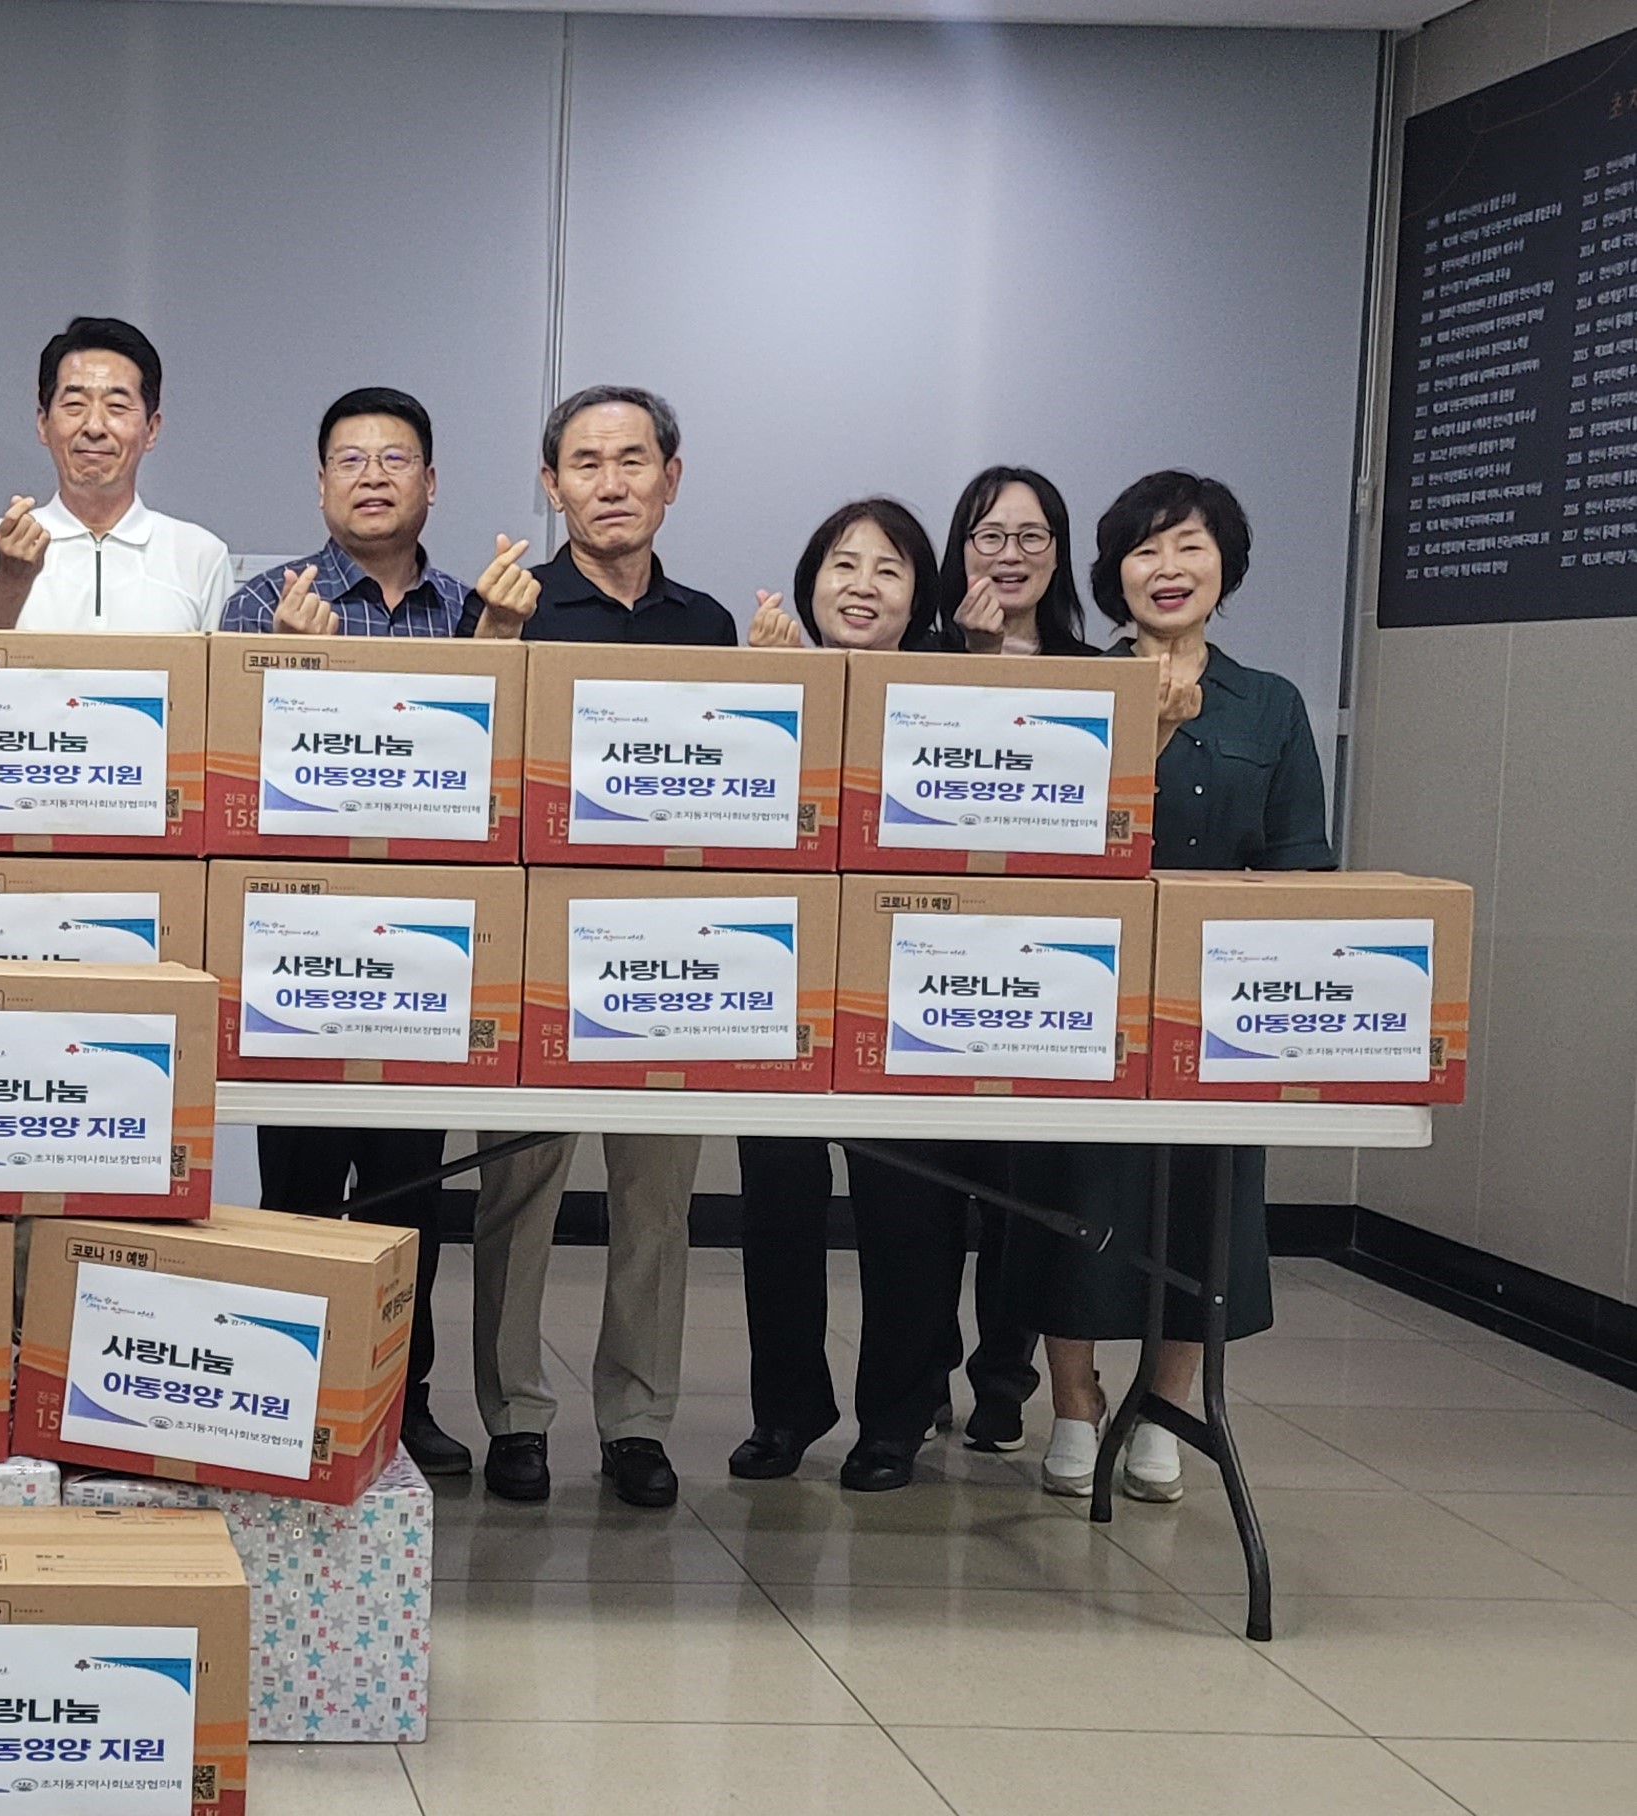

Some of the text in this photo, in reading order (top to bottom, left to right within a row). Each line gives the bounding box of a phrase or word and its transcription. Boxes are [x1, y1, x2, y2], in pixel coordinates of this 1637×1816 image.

[249, 656, 321, 670] 코로나 19 예방
[291, 733, 414, 756] 사랑나눔
[602, 743, 723, 765] 사랑나눔
[912, 747, 1033, 770] 사랑나눔
[88, 766, 142, 785] 지원
[295, 767, 467, 790] 아동영양 지원
[606, 777, 775, 797] 아동영양 지원
[916, 780, 1085, 804] 아동영양 지원
[880, 897, 952, 910] 코로나 19 예방
[272, 956, 395, 979] 사랑나눔
[599, 960, 720, 981] 사랑나눔
[919, 975, 1040, 998] 사랑나눔
[1231, 981, 1353, 1002] 사랑나눔
[276, 989, 447, 1012] 아동영양 지원
[604, 992, 774, 1012] 아동영양 지원
[922, 1008, 1093, 1030] 아동영양 지원
[1237, 1013, 1407, 1033] 아동영양 지원
[87, 1117, 146, 1139] 지원
[72, 1244, 149, 1267] 코로나 19 예방
[102, 1335, 234, 1376] 사랑나눔
[103, 1372, 290, 1420] 아동영양 지원
[99, 1739, 164, 1762] 지원
